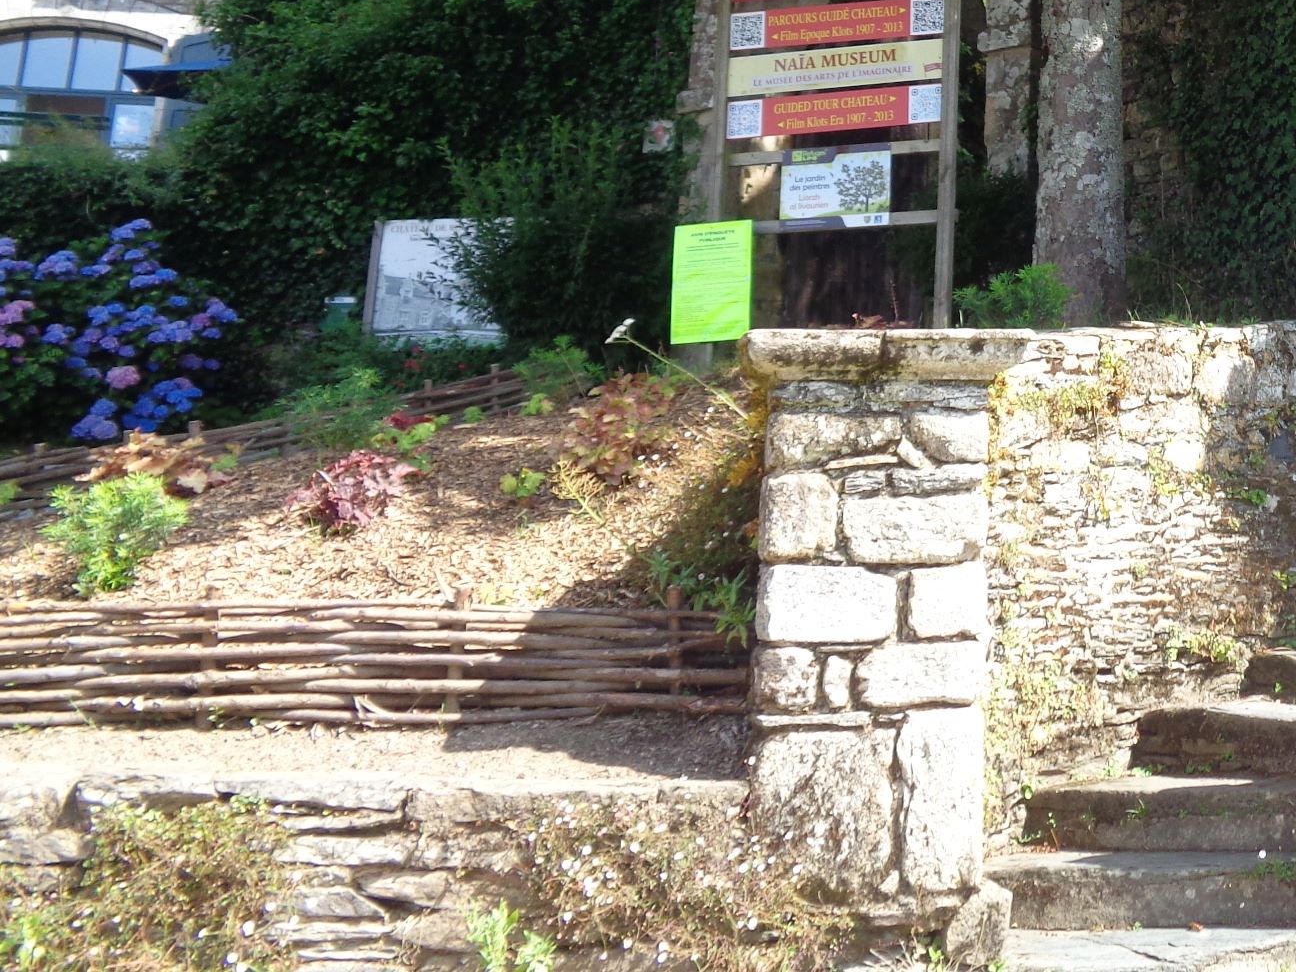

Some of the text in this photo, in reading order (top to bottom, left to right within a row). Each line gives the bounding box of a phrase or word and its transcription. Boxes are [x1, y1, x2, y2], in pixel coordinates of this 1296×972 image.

[768, 11, 817, 26] PARCOURS
[851, 6, 898, 21] CHATEAU
[780, 29, 799, 41] Film
[832, 25, 853, 37] Klots
[856, 23, 875, 35] 1907
[882, 21, 903, 32] 2013
[821, 48, 897, 68] MUSEUM
[797, 73, 812, 83] DES
[813, 71, 836, 81] ARTS
[837, 70, 850, 81] DE
[852, 65, 912, 78] L'IMAGINAIRE
[774, 94, 888, 114] GUIDED TOUR CHATEAU
[786, 117, 806, 129] Film
[807, 114, 828, 127] Klots
[830, 113, 844, 125] Era
[847, 112, 866, 124] 1907
[873, 110, 894, 122] 2013
[795, 174, 826, 184] Le jardin
